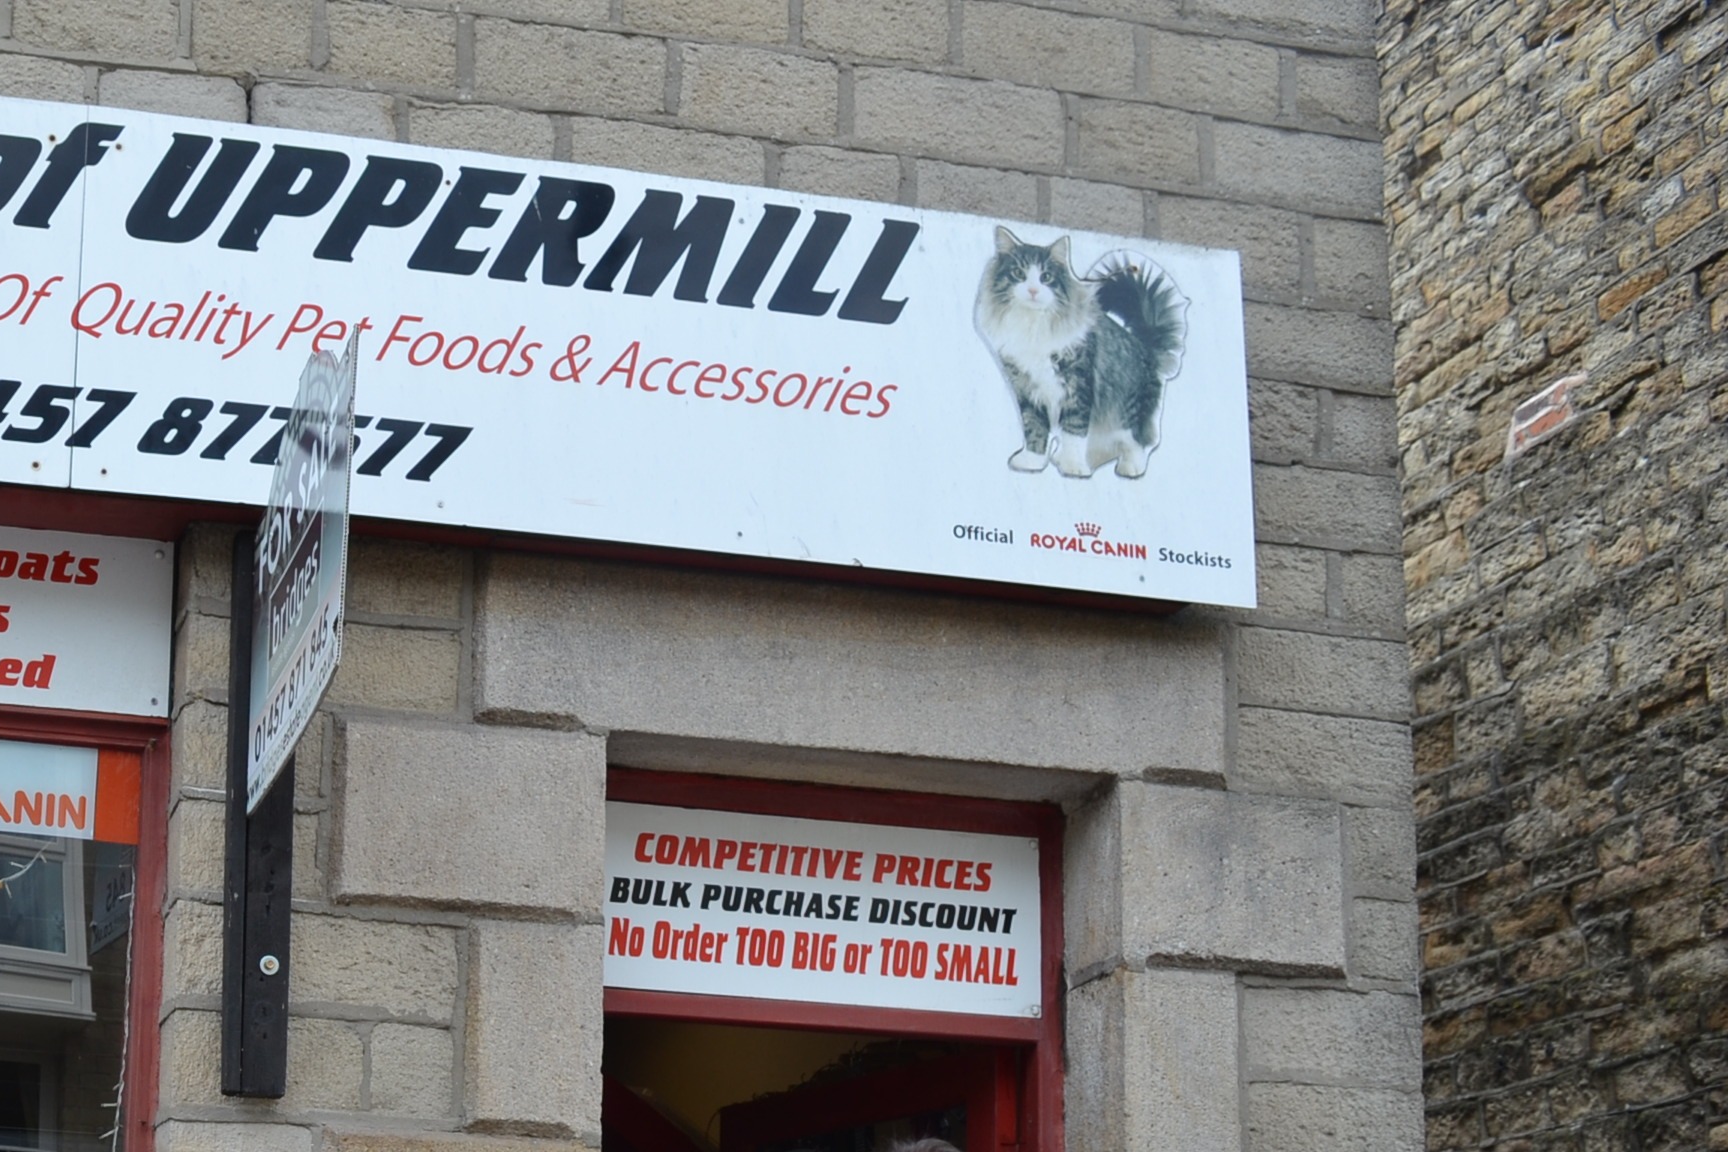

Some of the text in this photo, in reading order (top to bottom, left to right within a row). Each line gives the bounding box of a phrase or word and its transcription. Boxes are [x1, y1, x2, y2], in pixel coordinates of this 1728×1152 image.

[125, 131, 920, 325] UPPERMILL
[71, 281, 275, 361] Quality
[375, 314, 544, 378] Foods
[548, 334, 594, 383] &
[597, 340, 899, 419] Accessories
[258, 394, 339, 594] FOR SALE
[953, 524, 1232, 569] Official ROYAL CANIN Stockists
[272, 541, 318, 652] bridges
[255, 603, 329, 763] 01457 871 845
[609, 876, 1017, 934] BULK PURCHASE DISCOUNT
[634, 832, 993, 892] COMPETITIVE PRICES
[608, 917, 1018, 986] No Order TOO BIG or TOO SMALL
